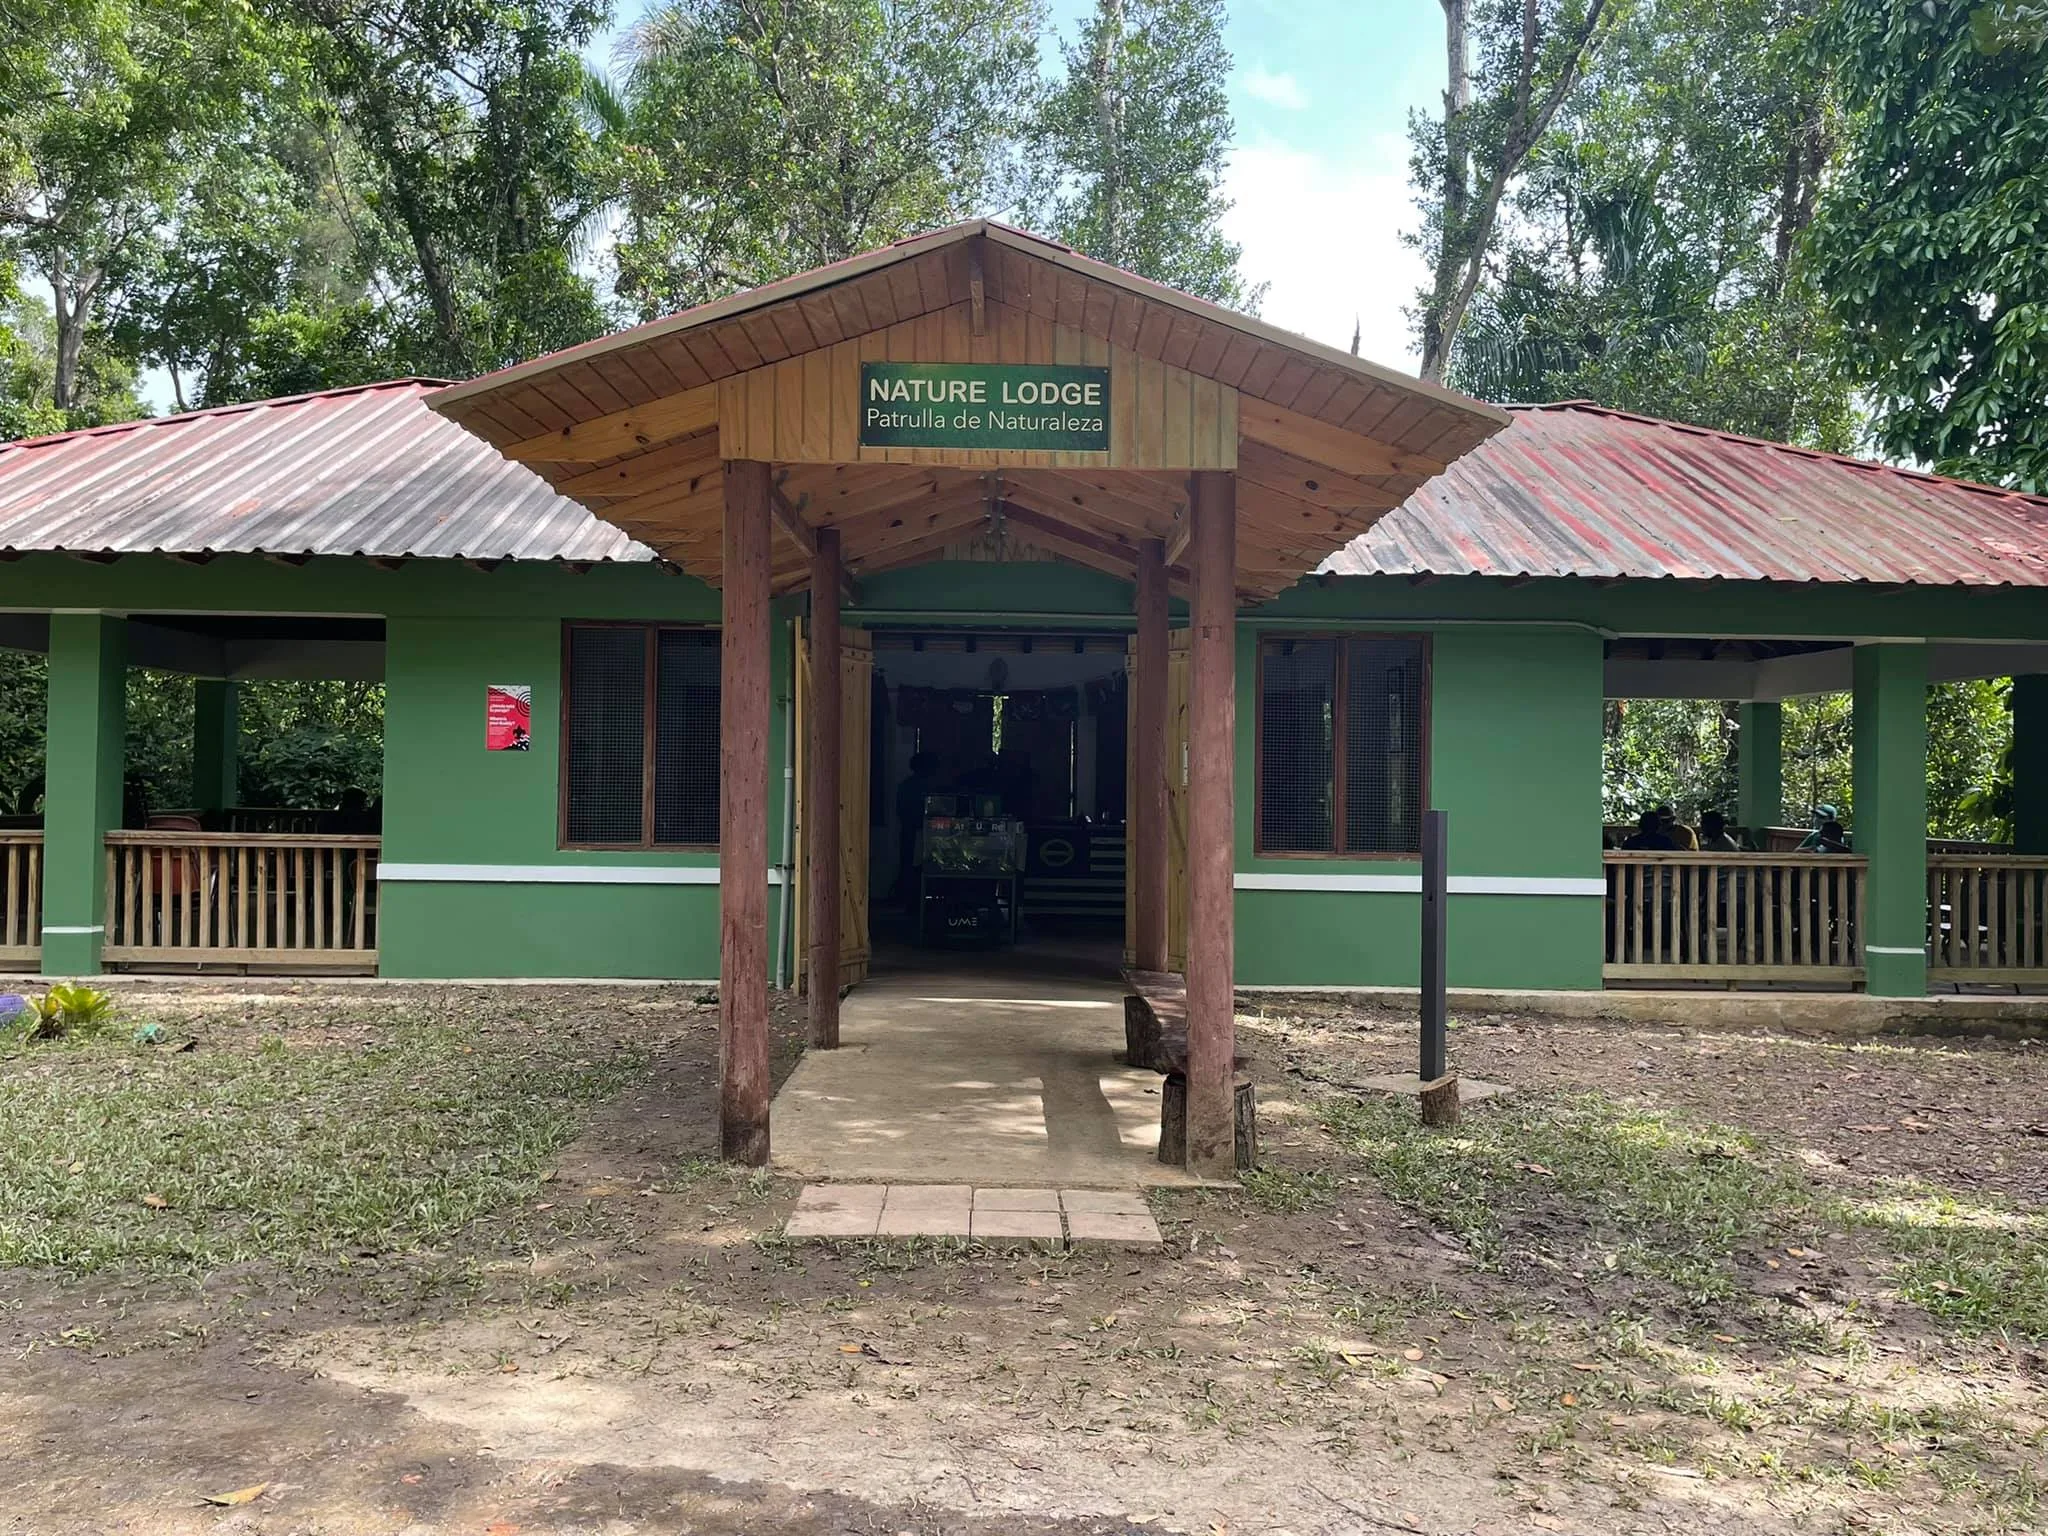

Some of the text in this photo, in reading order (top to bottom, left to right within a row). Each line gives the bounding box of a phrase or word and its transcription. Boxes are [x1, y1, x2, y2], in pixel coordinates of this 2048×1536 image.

[870, 378, 1101, 405] NATURE LODGE
[867, 407, 1103, 432] Patrulla de Naturaleza
